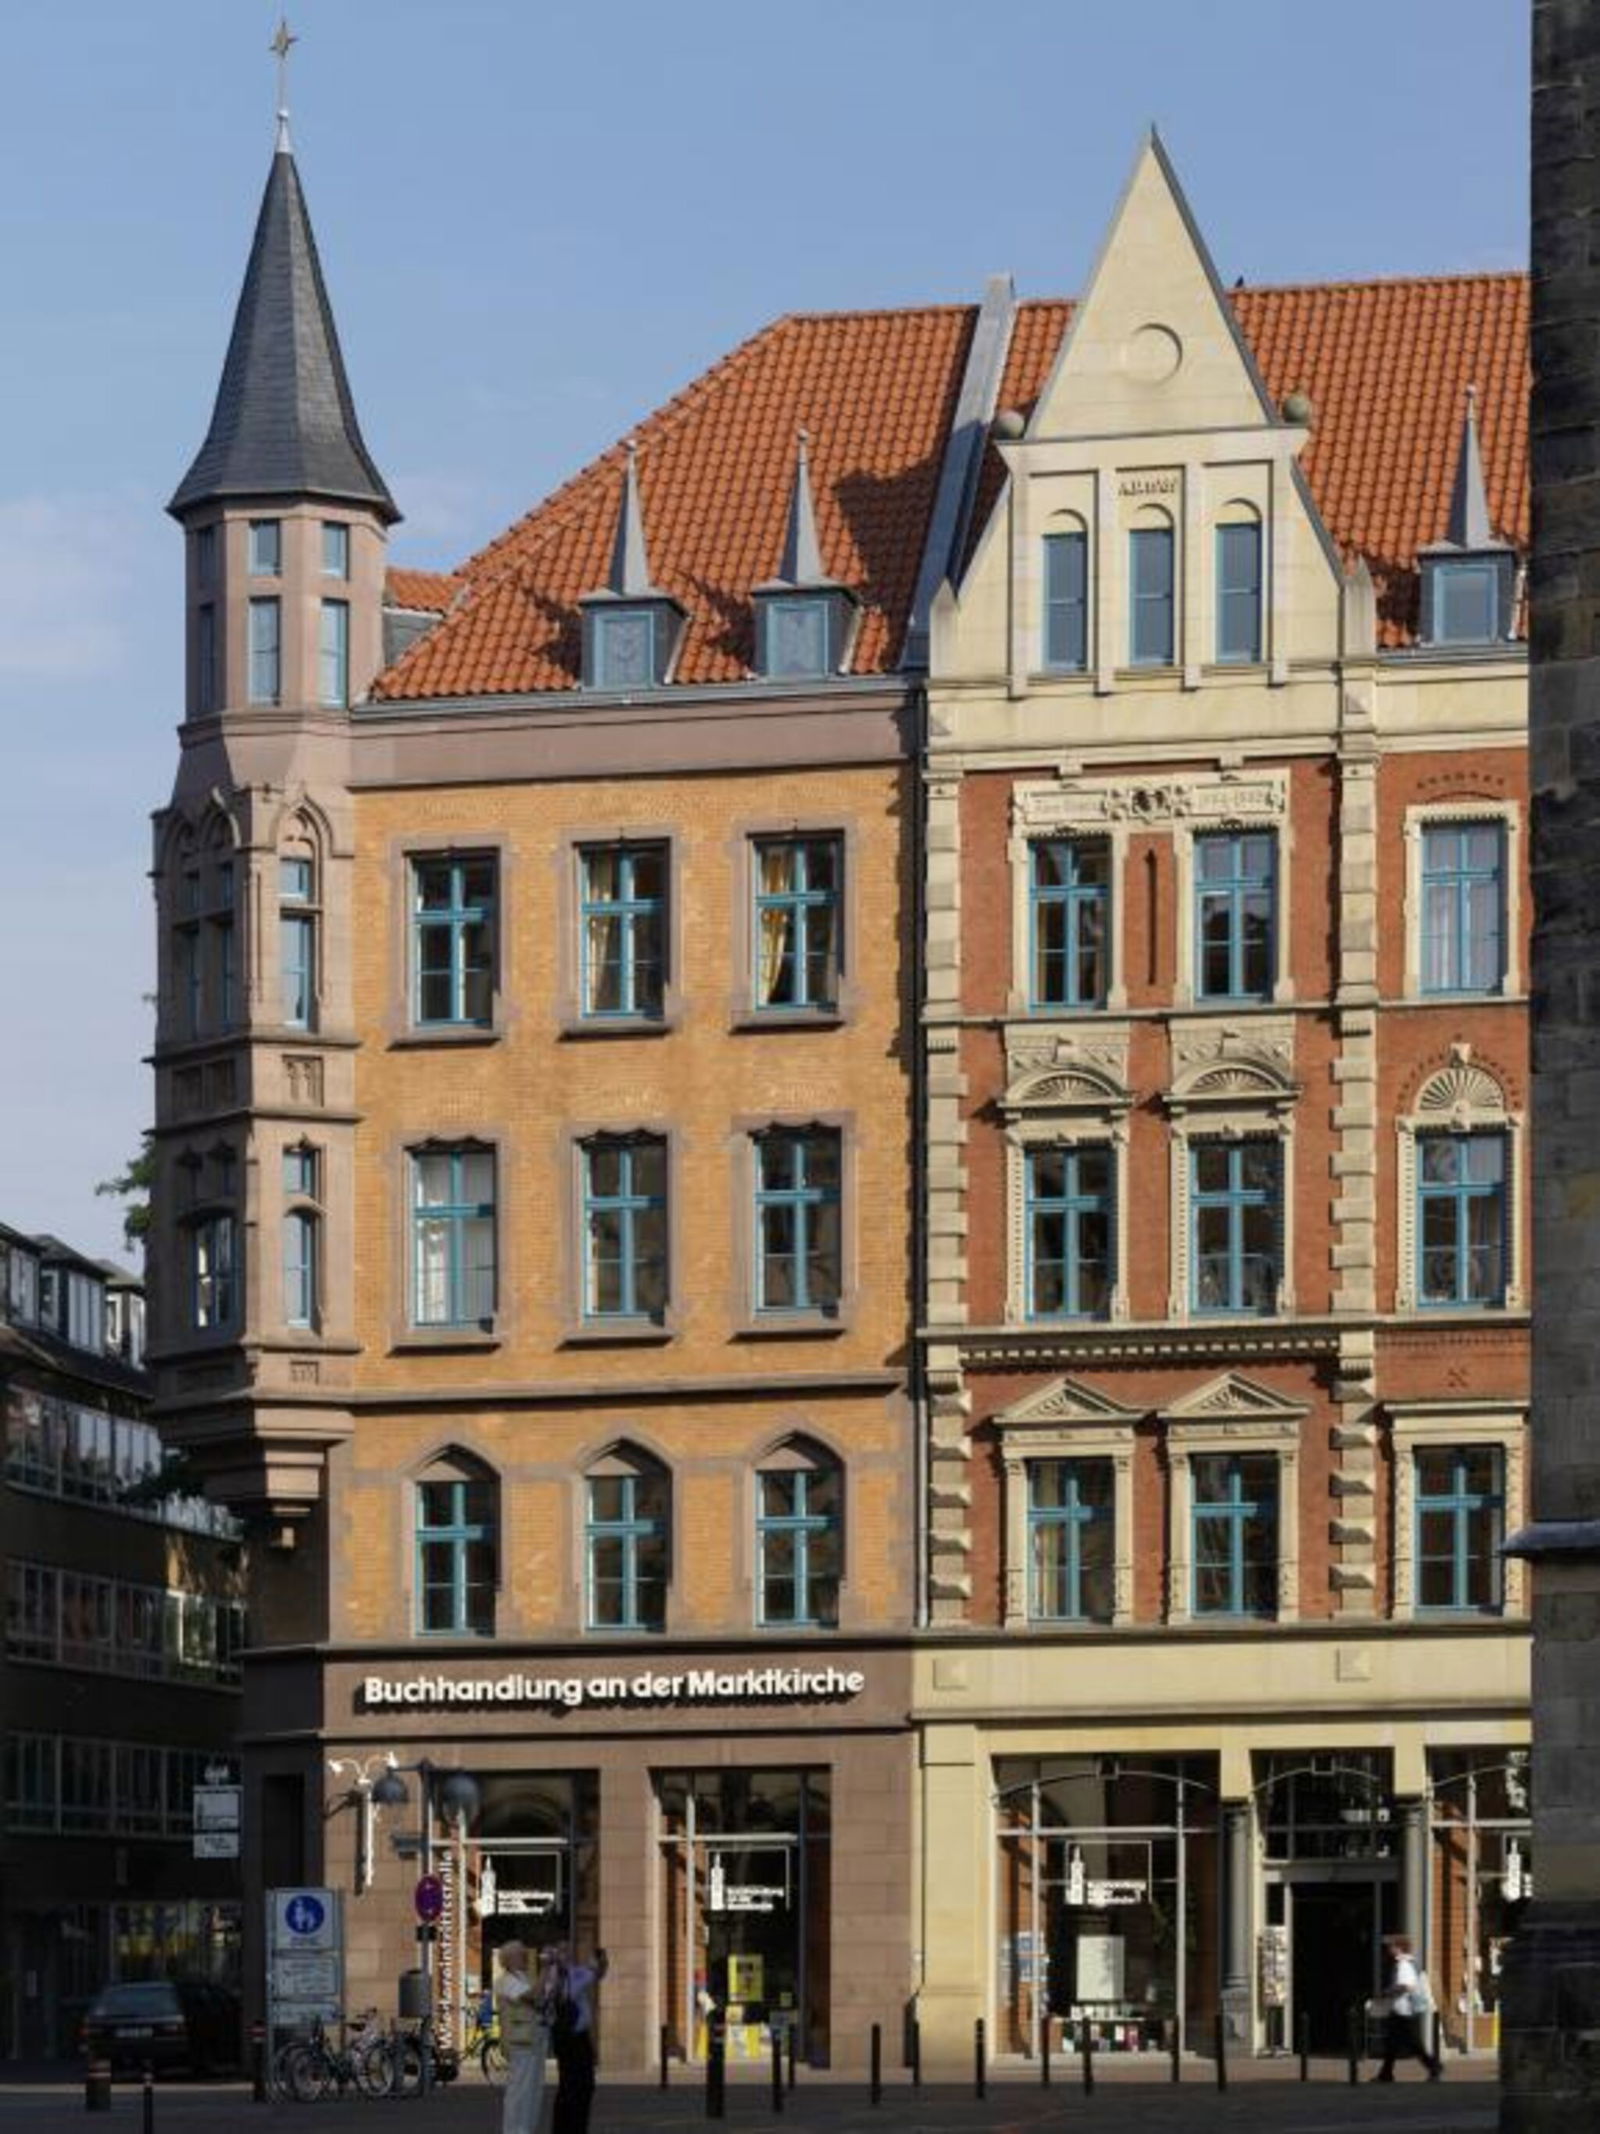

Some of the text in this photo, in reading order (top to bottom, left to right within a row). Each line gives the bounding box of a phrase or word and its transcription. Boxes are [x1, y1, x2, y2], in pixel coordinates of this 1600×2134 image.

[363, 1668, 865, 1706] Buchhandlung an der Marktkirche
